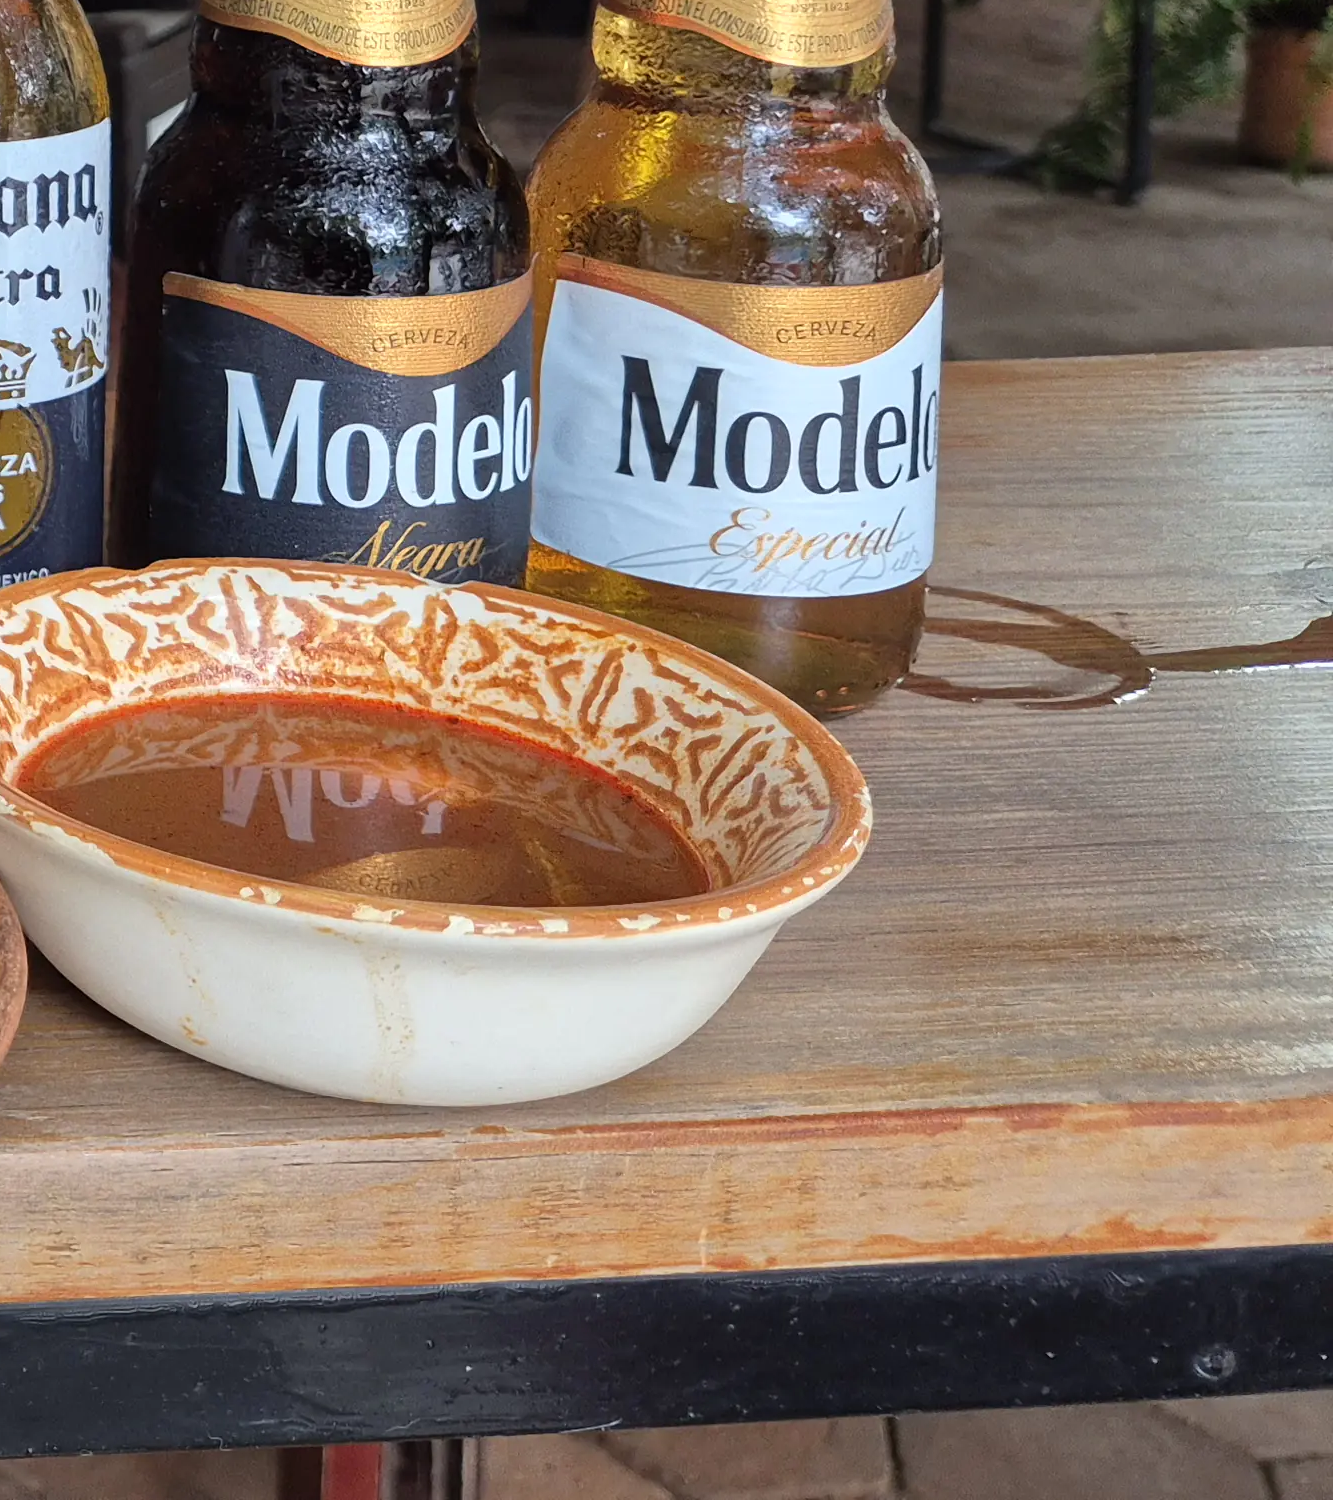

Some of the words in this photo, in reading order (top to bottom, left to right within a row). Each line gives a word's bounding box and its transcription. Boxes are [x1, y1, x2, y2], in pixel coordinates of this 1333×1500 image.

[274, 2, 285, 21] EL
[287, 7, 344, 44] CONSUMO
[344, 28, 361, 48] DE
[363, 32, 391, 49] ESTE
[694, 1, 706, 22] EL
[709, 7, 769, 46] CONSUMO
[770, 29, 786, 49] DE
[788, 33, 815, 53] ESTE
[371, 327, 470, 354] CERVEZA
[776, 320, 879, 345] CERVEZA
[221, 368, 532, 509] Modelo
[615, 354, 937, 495] Modelo
[348, 520, 486, 577] Negra
[708, 506, 907, 573] Especial
